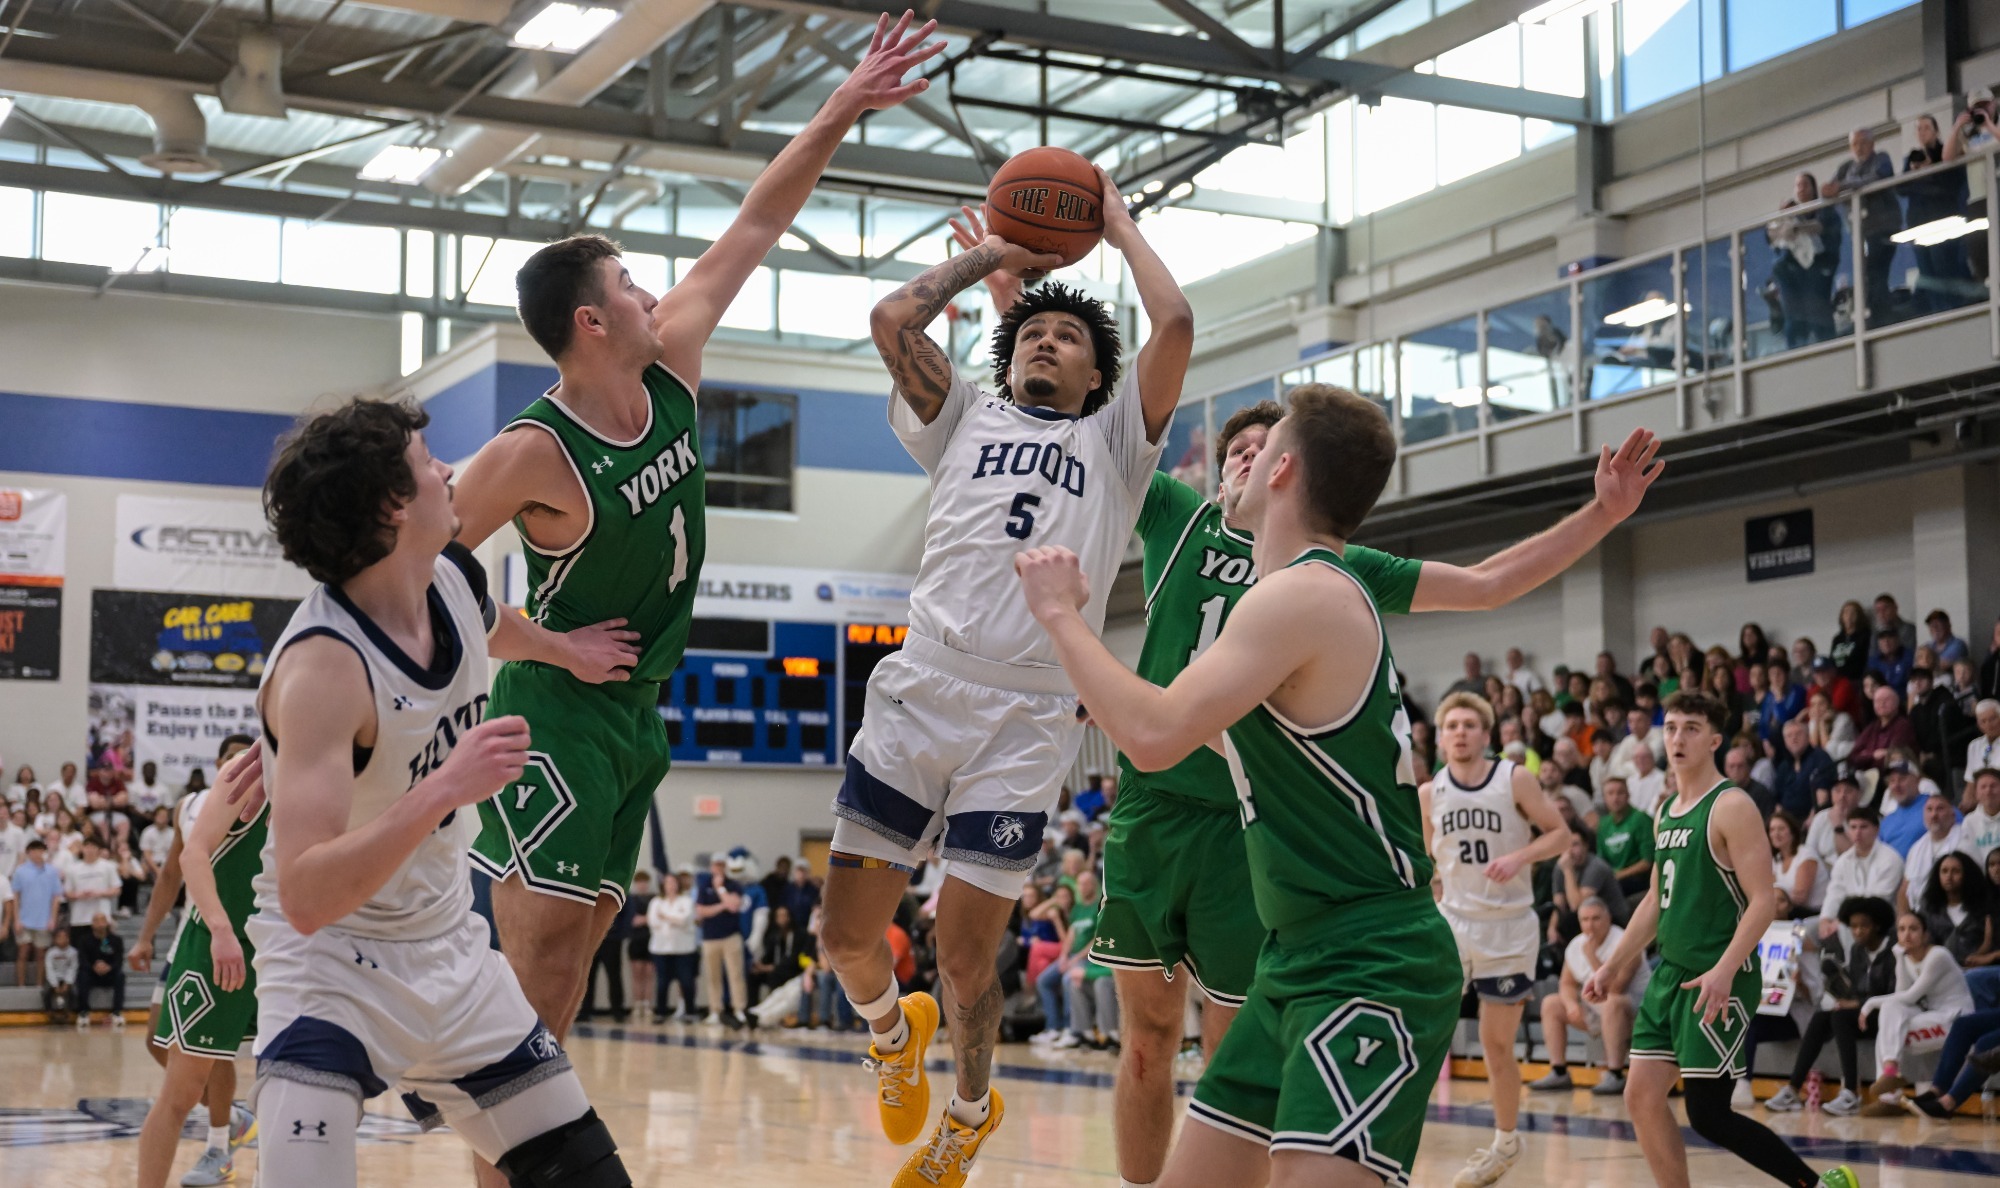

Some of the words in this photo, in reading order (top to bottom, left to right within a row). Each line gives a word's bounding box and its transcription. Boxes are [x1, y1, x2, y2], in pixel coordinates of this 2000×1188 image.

[1010, 187, 1050, 217] THE
[1053, 189, 1097, 222] ROCK
[617, 430, 698, 517] YORK
[971, 442, 1085, 498] HOOD
[1005, 492, 1042, 541] 5
[667, 503, 689, 594] 1
[1199, 547, 1259, 586] YO
[164, 606, 202, 629] CAR
[205, 601, 254, 624] CARE
[147, 702, 203, 718] Pause
[208, 705, 237, 718] the
[147, 721, 199, 739] Enjoy
[204, 723, 234, 737] the
[514, 784, 539, 810] Y
[1442, 807, 1503, 836] HOOD
[1459, 838, 1490, 865] 20
[1660, 858, 1676, 910] 3
[182, 990, 195, 1006] Y
[1724, 1016, 1736, 1032] Y
[1354, 1035, 1384, 1067] Y
